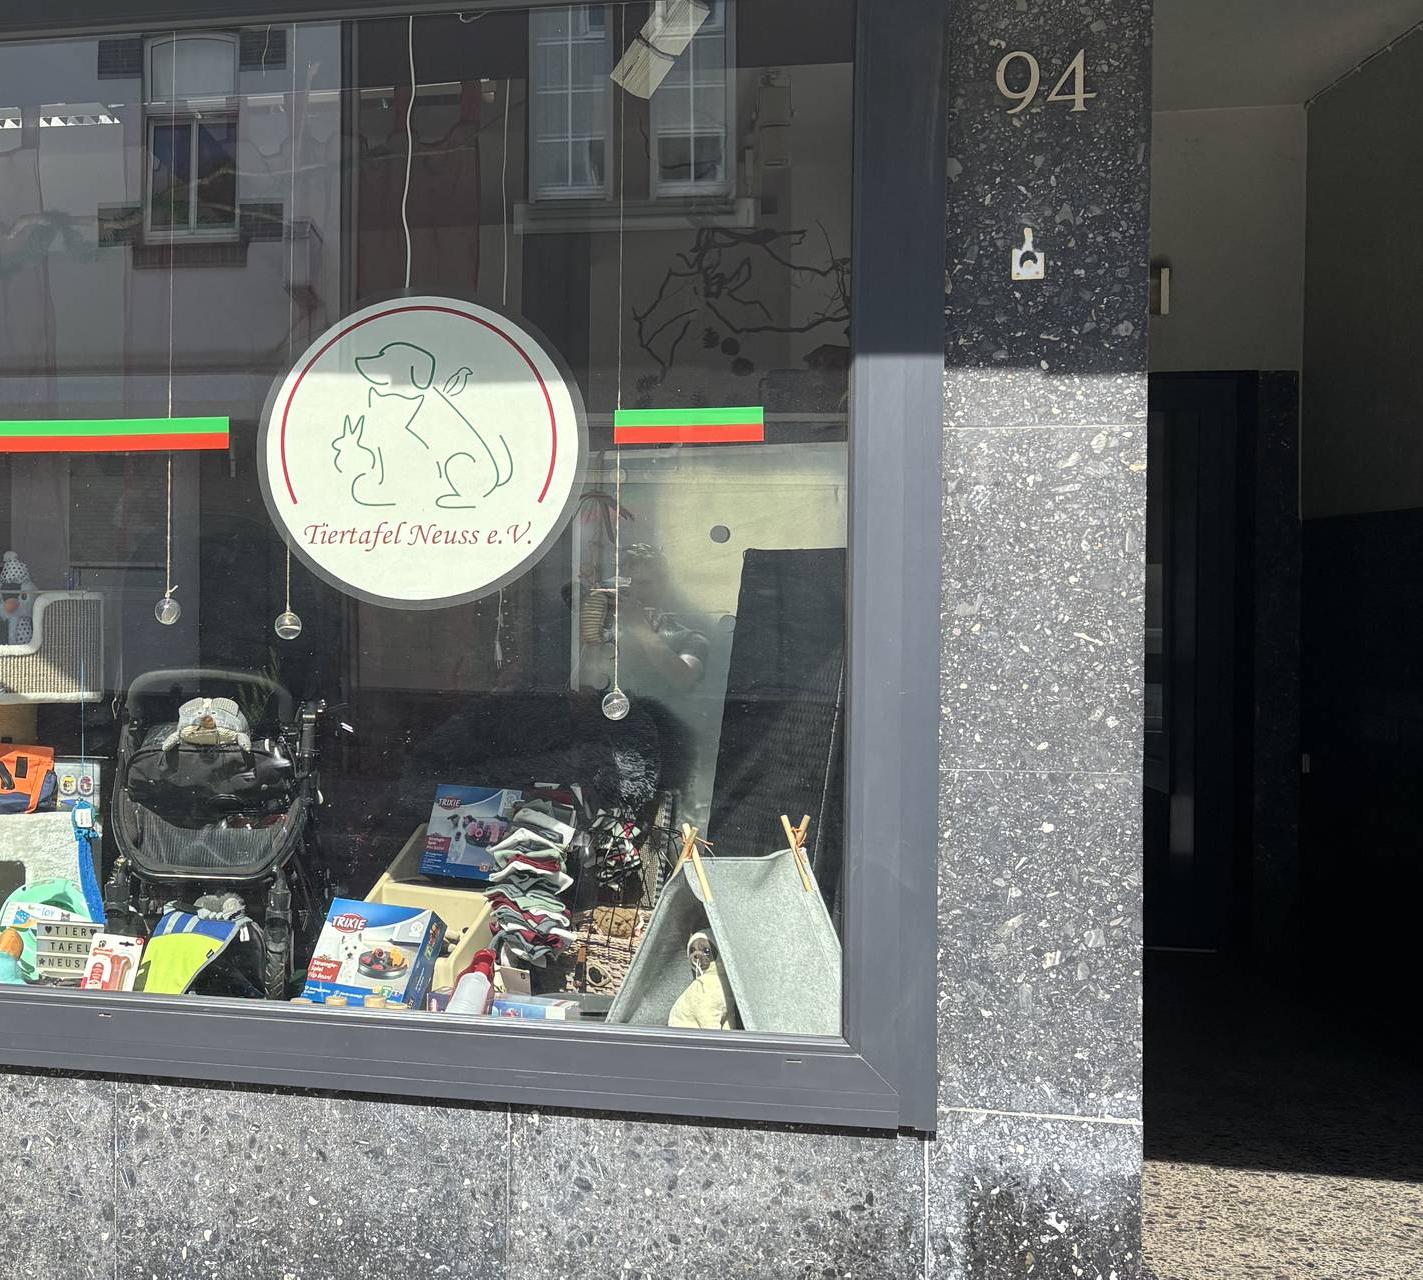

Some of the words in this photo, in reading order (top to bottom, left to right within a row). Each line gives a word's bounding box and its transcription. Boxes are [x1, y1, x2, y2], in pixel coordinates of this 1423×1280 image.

[995, 48, 1097, 114] 94
[304, 522, 405, 551] Tiertafel
[407, 524, 479, 546] Neuss
[487, 521, 532, 545] e.V.
[438, 798, 461, 807] TRIXIE
[332, 916, 367, 930] TRIXIE
[55, 926, 87, 937] TIER
[51, 942, 90, 952] TAFEL
[49, 958, 87, 968] NEUS
